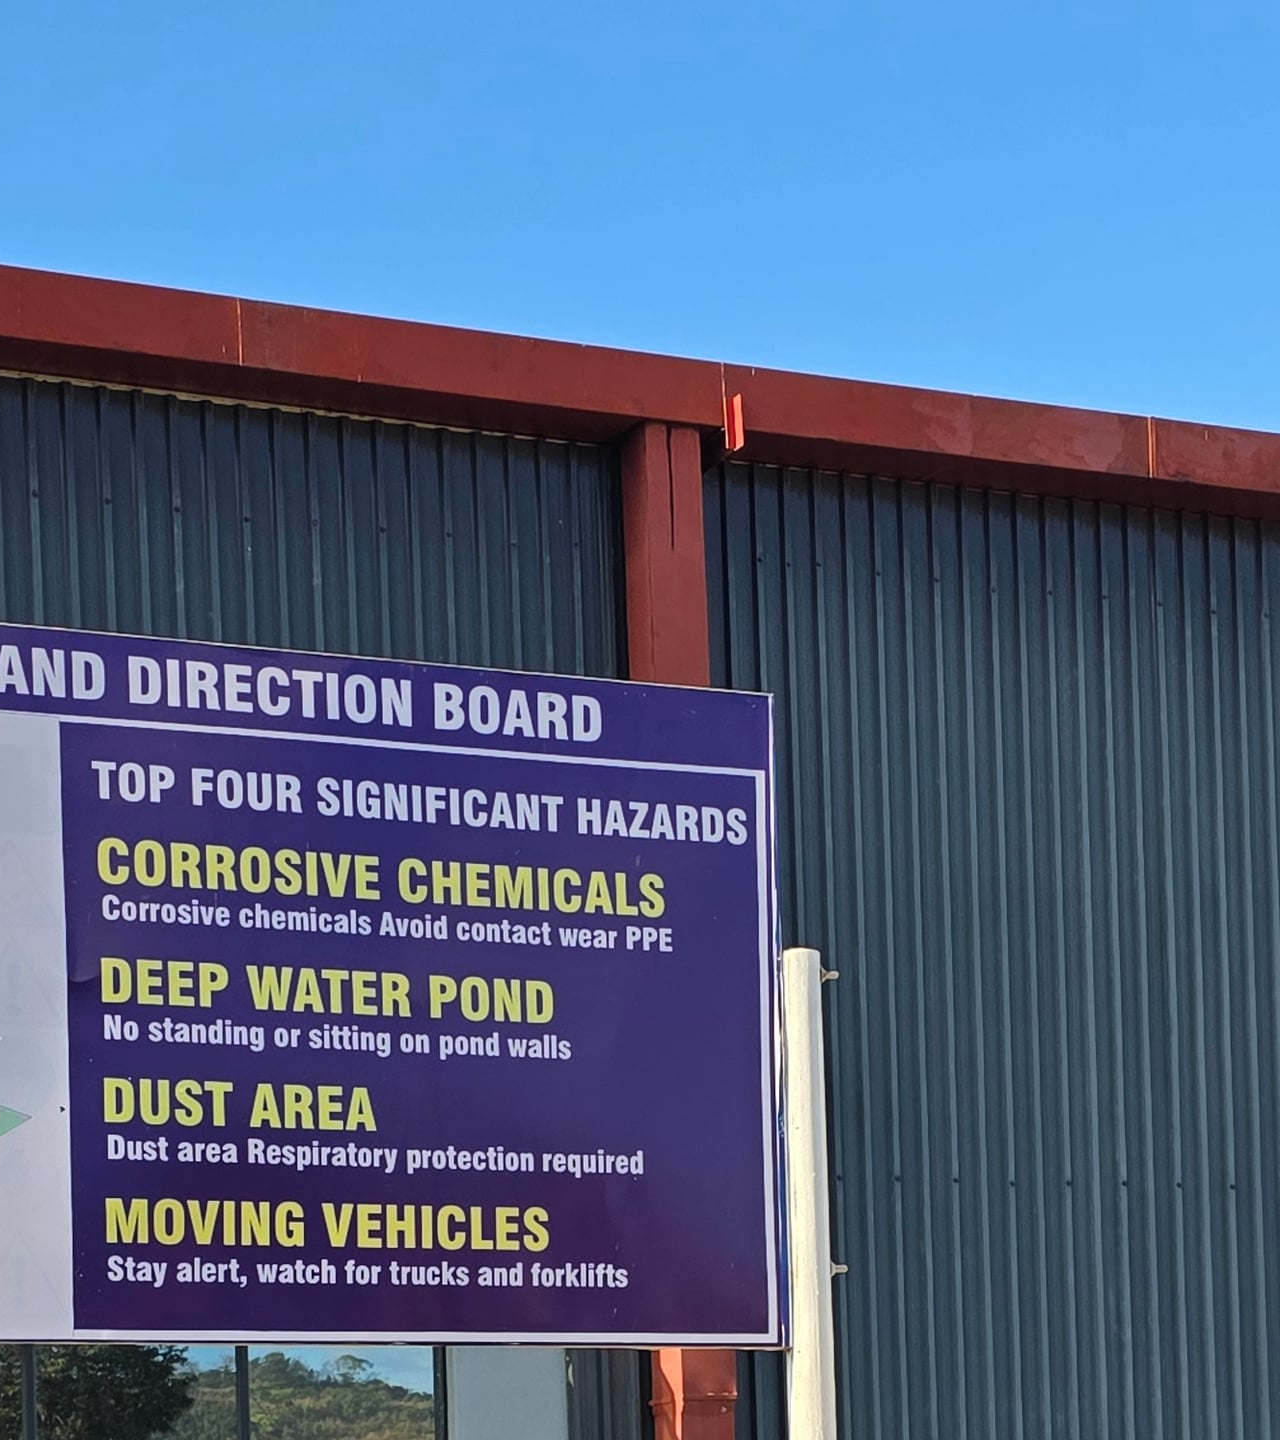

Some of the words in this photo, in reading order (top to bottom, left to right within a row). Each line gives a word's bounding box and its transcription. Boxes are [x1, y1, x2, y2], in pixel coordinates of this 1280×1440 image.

[128, 656, 412, 726] DIRECTION
[434, 683, 601, 742] BOARD
[92, 761, 174, 802] TOP
[192, 768, 302, 813] FOUR
[317, 778, 563, 832] SIGNIFICANT
[578, 798, 747, 844] HAZARDS
[98, 838, 380, 900] CORROSIVE
[399, 858, 664, 919] CHEMICALS
[102, 894, 230, 926] Corrosive
[239, 903, 371, 935] chemicals
[380, 912, 448, 939] Avoid
[457, 920, 551, 945] contact
[559, 928, 617, 948] wear
[626, 926, 672, 952] PPE
[101, 958, 228, 1007] DEEP
[246, 966, 411, 1017] WATER
[430, 975, 553, 1023] POND
[104, 1014, 138, 1041] No
[149, 1018, 264, 1052] standing
[274, 1028, 300, 1047] or
[309, 1024, 390, 1057] sitting
[400, 1034, 430, 1053] on
[440, 1032, 499, 1060] pond
[508, 1034, 571, 1059] walls
[104, 1078, 233, 1126] DUST
[250, 1084, 376, 1131] AREA
[108, 1134, 168, 1161] Dust
[178, 1142, 238, 1163] area
[248, 1138, 398, 1173] Respiratory
[407, 1146, 534, 1174] protection
[543, 1150, 643, 1178] required
[106, 1198, 304, 1246] MOVING
[322, 1203, 549, 1251] VEHICLES
[108, 1256, 167, 1287] Stay
[177, 1258, 247, 1287] alert,
[257, 1259, 336, 1284] watch
[344, 1260, 381, 1284] for
[389, 1262, 469, 1286] trucks
[478, 1262, 522, 1286] and
[531, 1263, 628, 1287] forklifts
